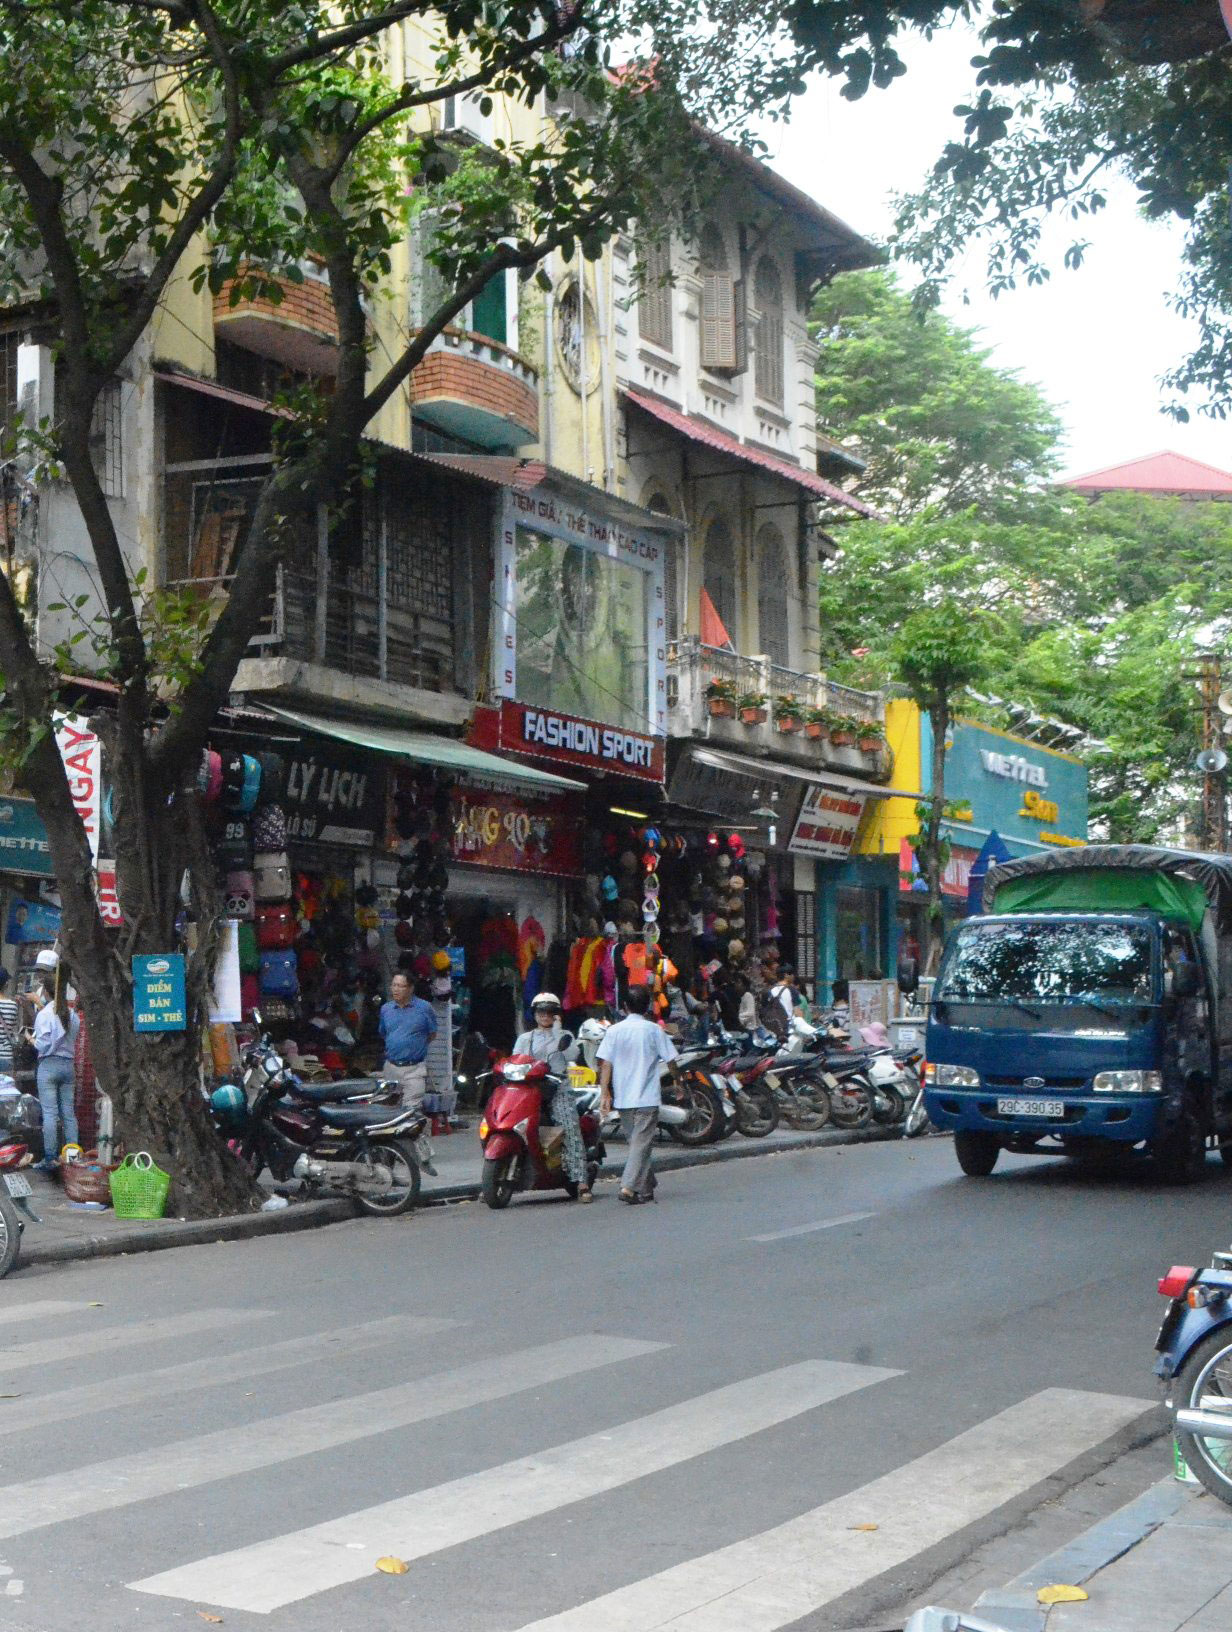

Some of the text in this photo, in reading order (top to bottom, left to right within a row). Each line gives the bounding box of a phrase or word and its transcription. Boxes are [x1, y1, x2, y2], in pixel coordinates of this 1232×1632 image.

[524, 711, 655, 768] FASHION SPORT
[137, 1013, 156, 1023] SIM
